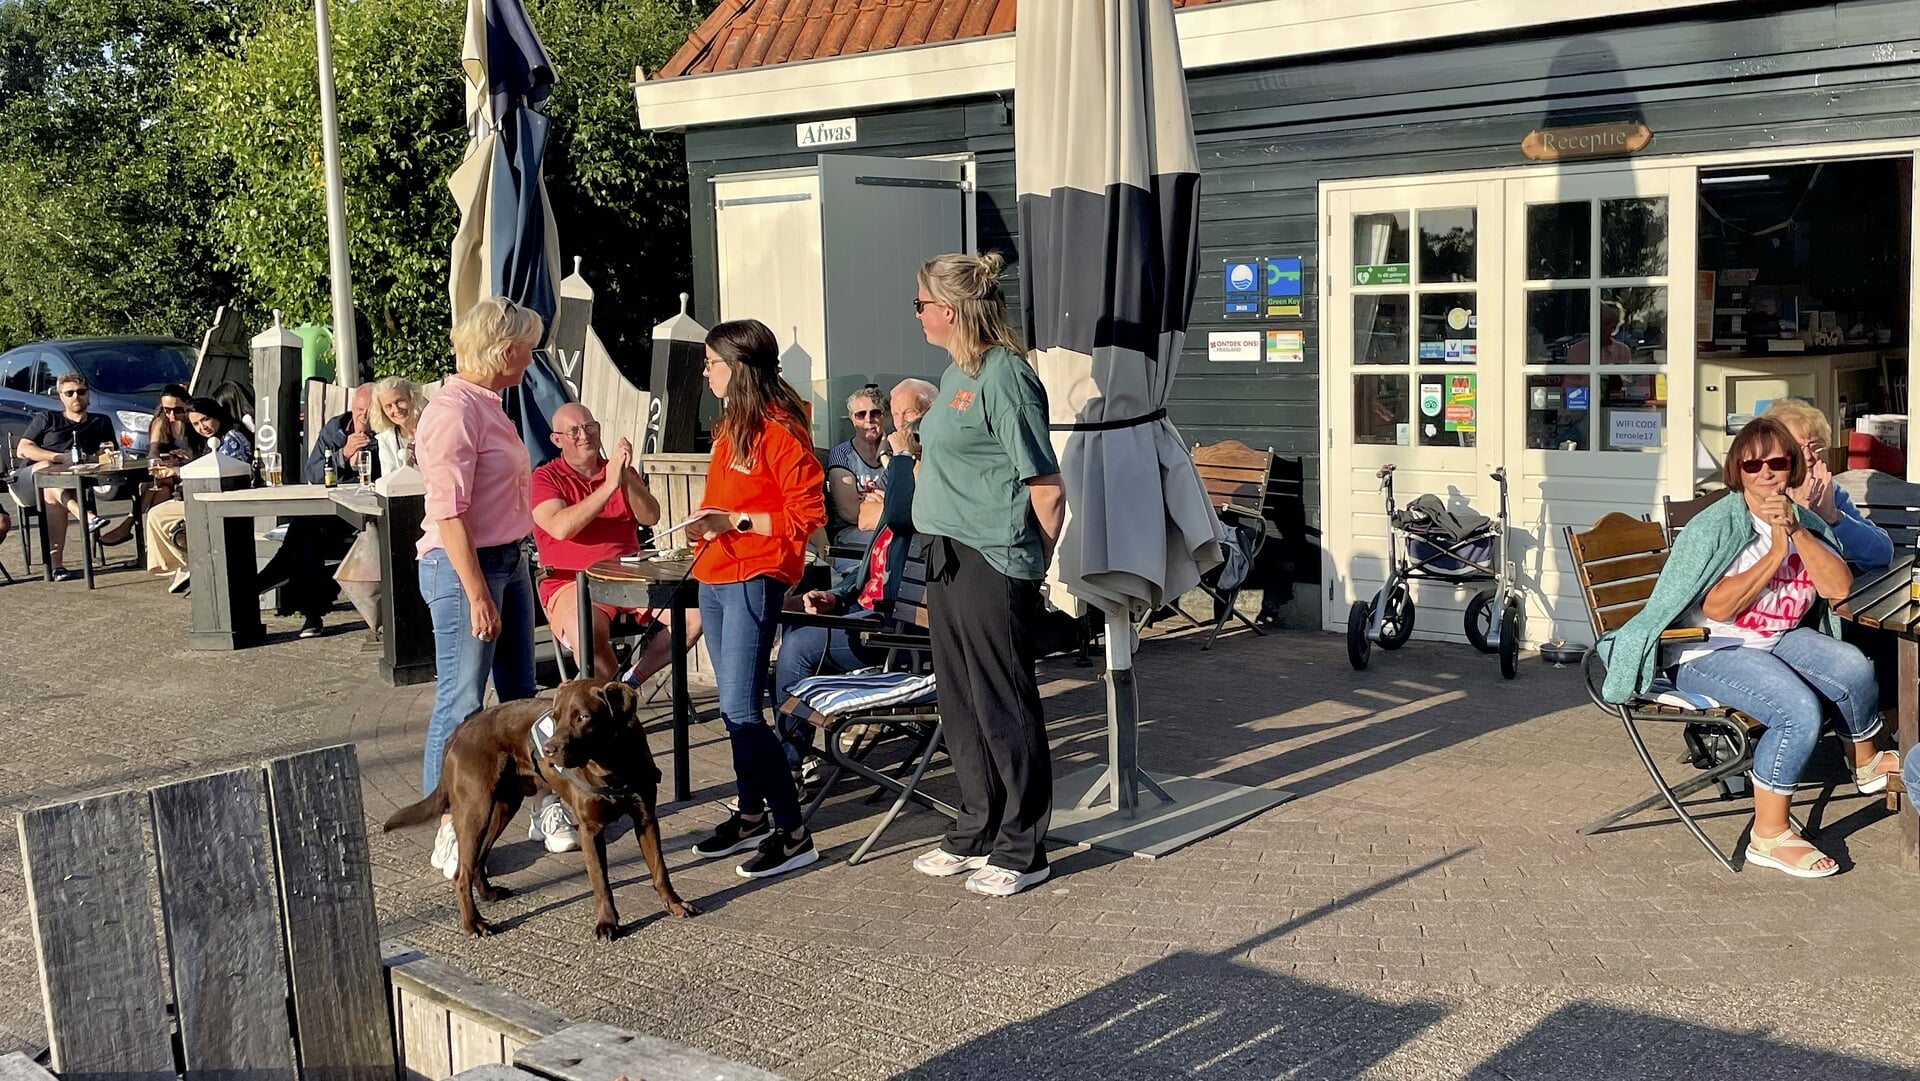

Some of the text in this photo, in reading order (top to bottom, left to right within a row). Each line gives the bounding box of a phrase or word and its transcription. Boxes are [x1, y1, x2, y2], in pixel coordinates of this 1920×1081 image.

[802, 123, 852, 144] Afwas
[1543, 131, 1627, 152] Receptie
[1287, 297, 1301, 306] Key
[1615, 420, 1657, 429] WIFI CODE
